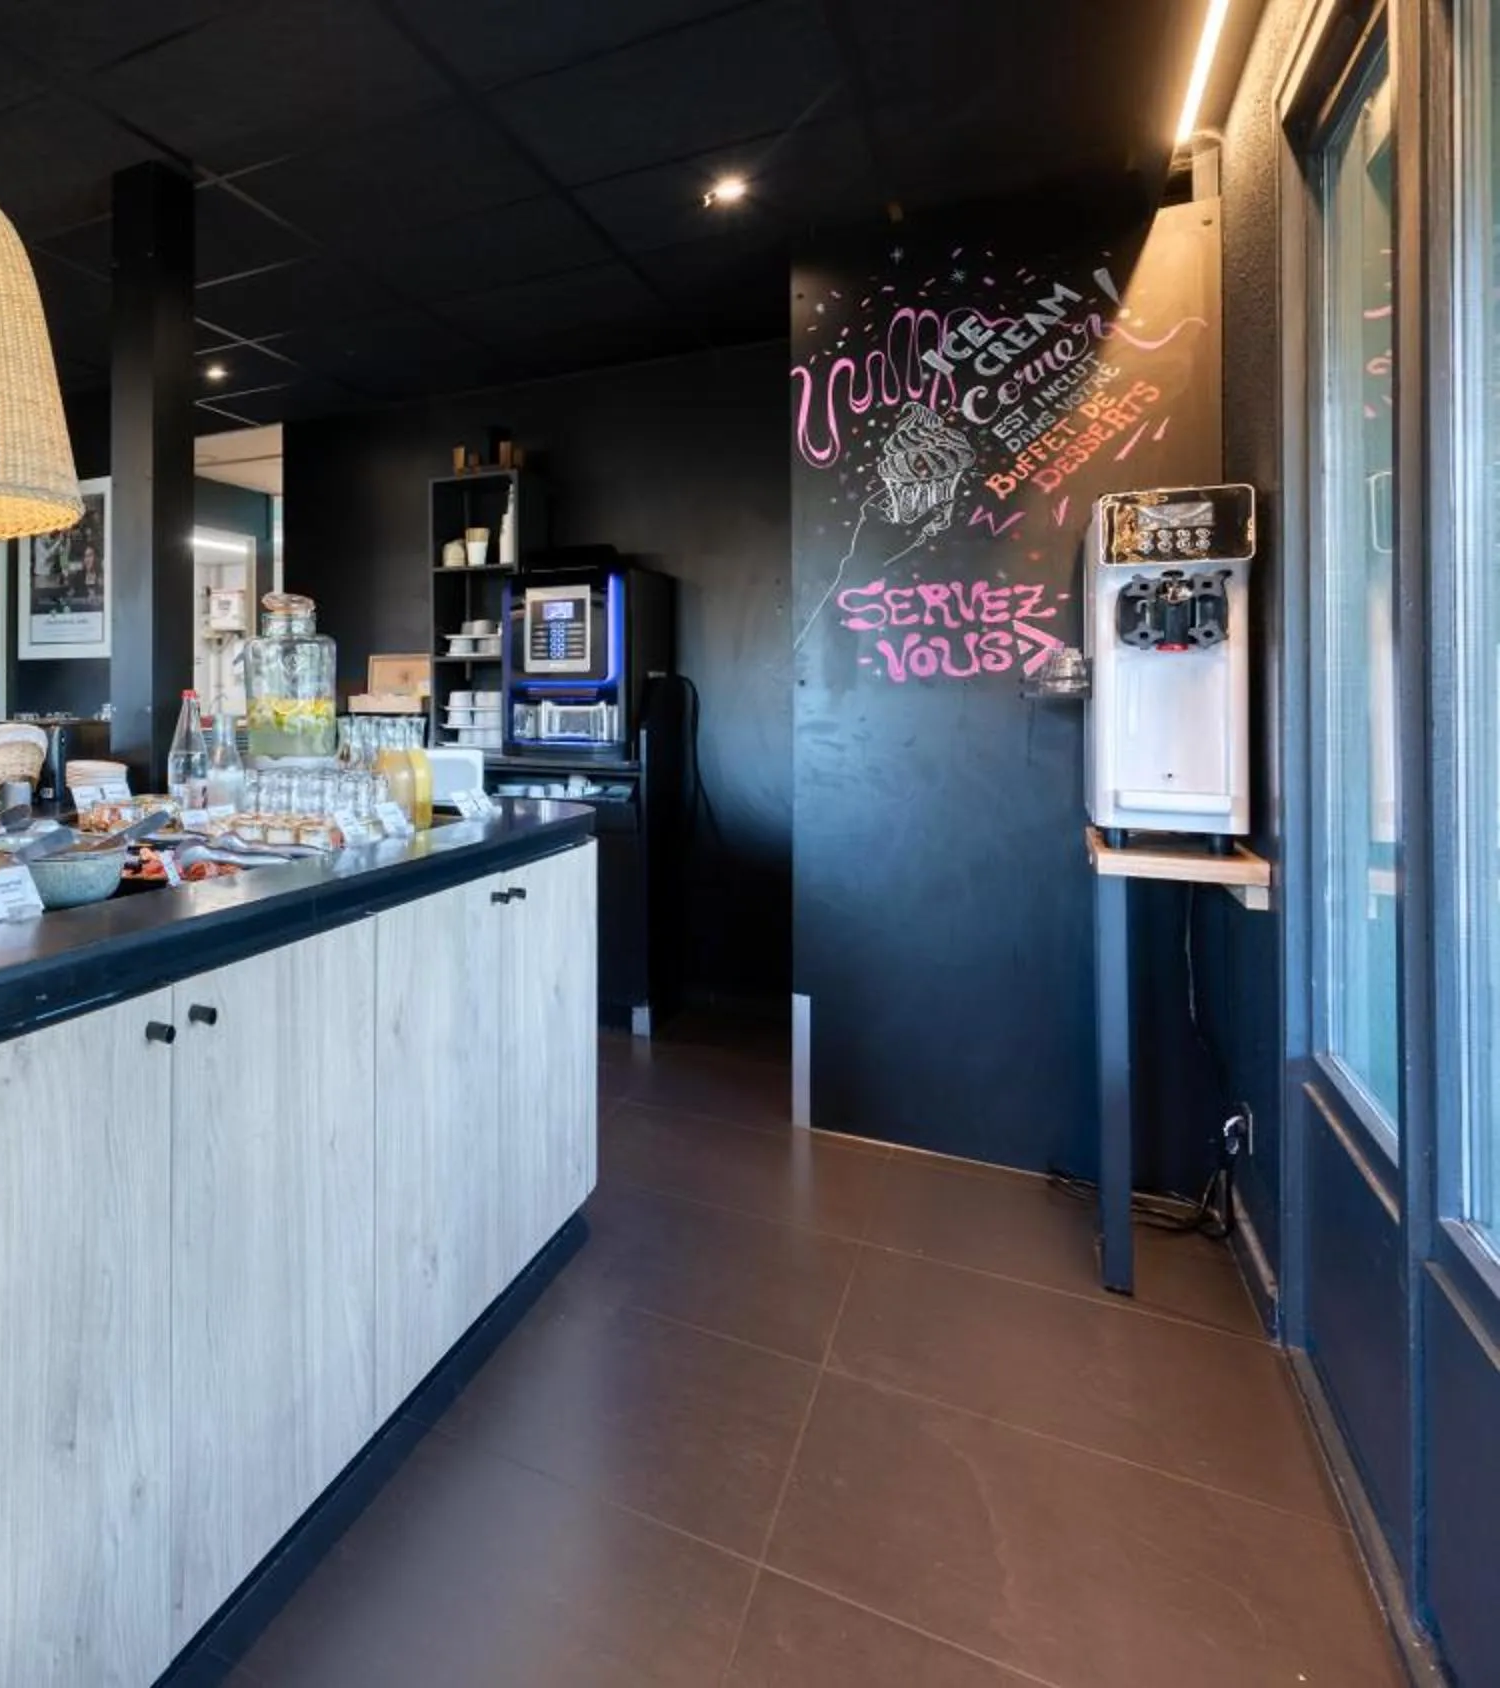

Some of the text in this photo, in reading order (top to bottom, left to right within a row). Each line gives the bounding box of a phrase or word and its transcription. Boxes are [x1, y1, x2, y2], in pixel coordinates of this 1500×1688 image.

[922, 315, 995, 376] ICE
[974, 283, 1083, 376] CREAM
[992, 351, 1100, 439] EST INCLUT
[1005, 362, 1121, 453] DANS VOTRE
[1030, 380, 1160, 494] DESSERTS
[985, 391, 1116, 500] BUFFET DE
